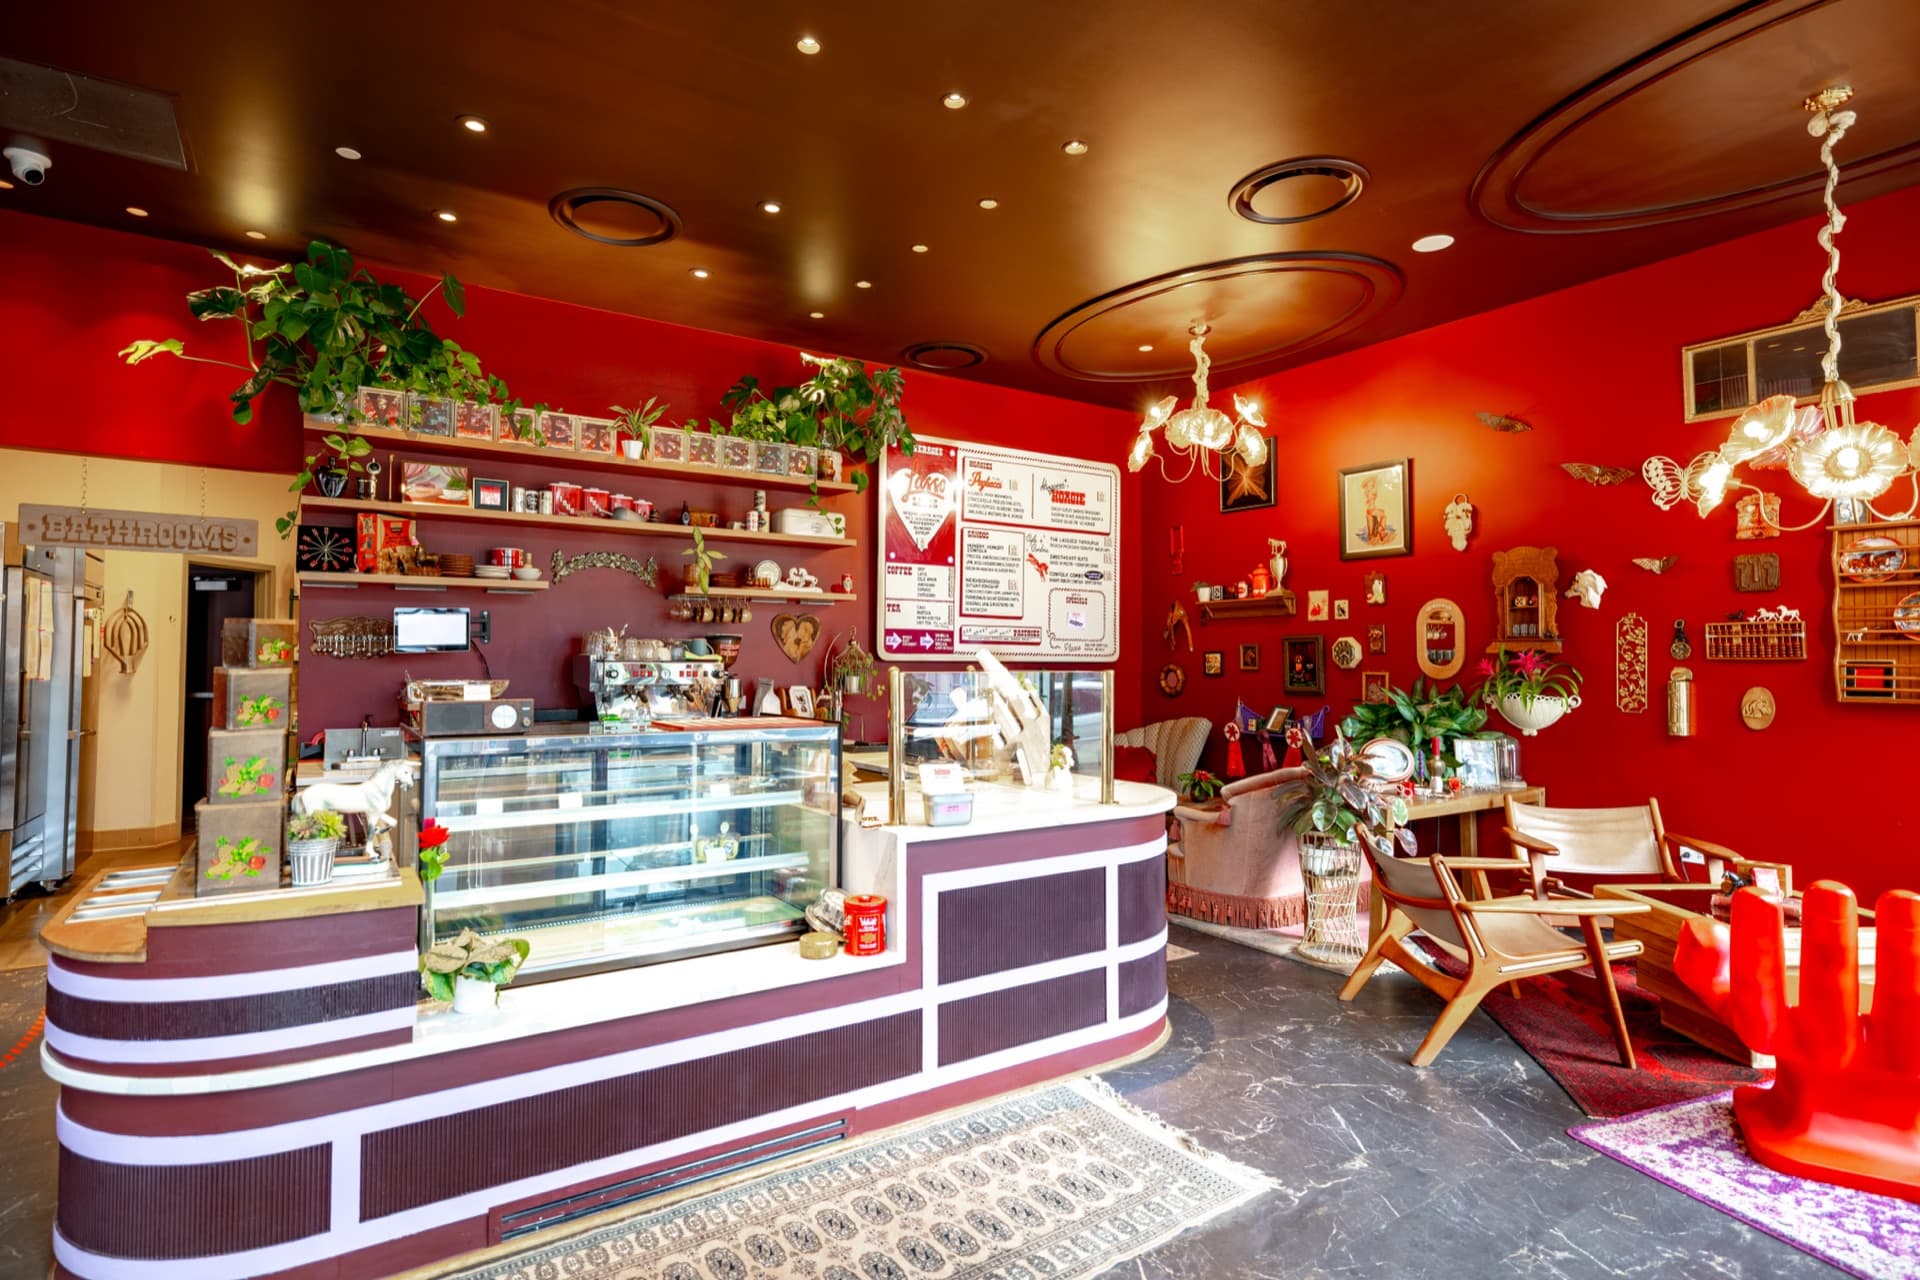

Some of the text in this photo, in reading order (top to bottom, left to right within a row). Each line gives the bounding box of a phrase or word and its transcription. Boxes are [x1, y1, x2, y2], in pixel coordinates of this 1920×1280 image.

[902, 457, 946, 503] Lasso
[42, 513, 238, 552] BATHROOMS
[886, 565, 913, 576] COFFEE
[886, 603, 901, 613] TEA
